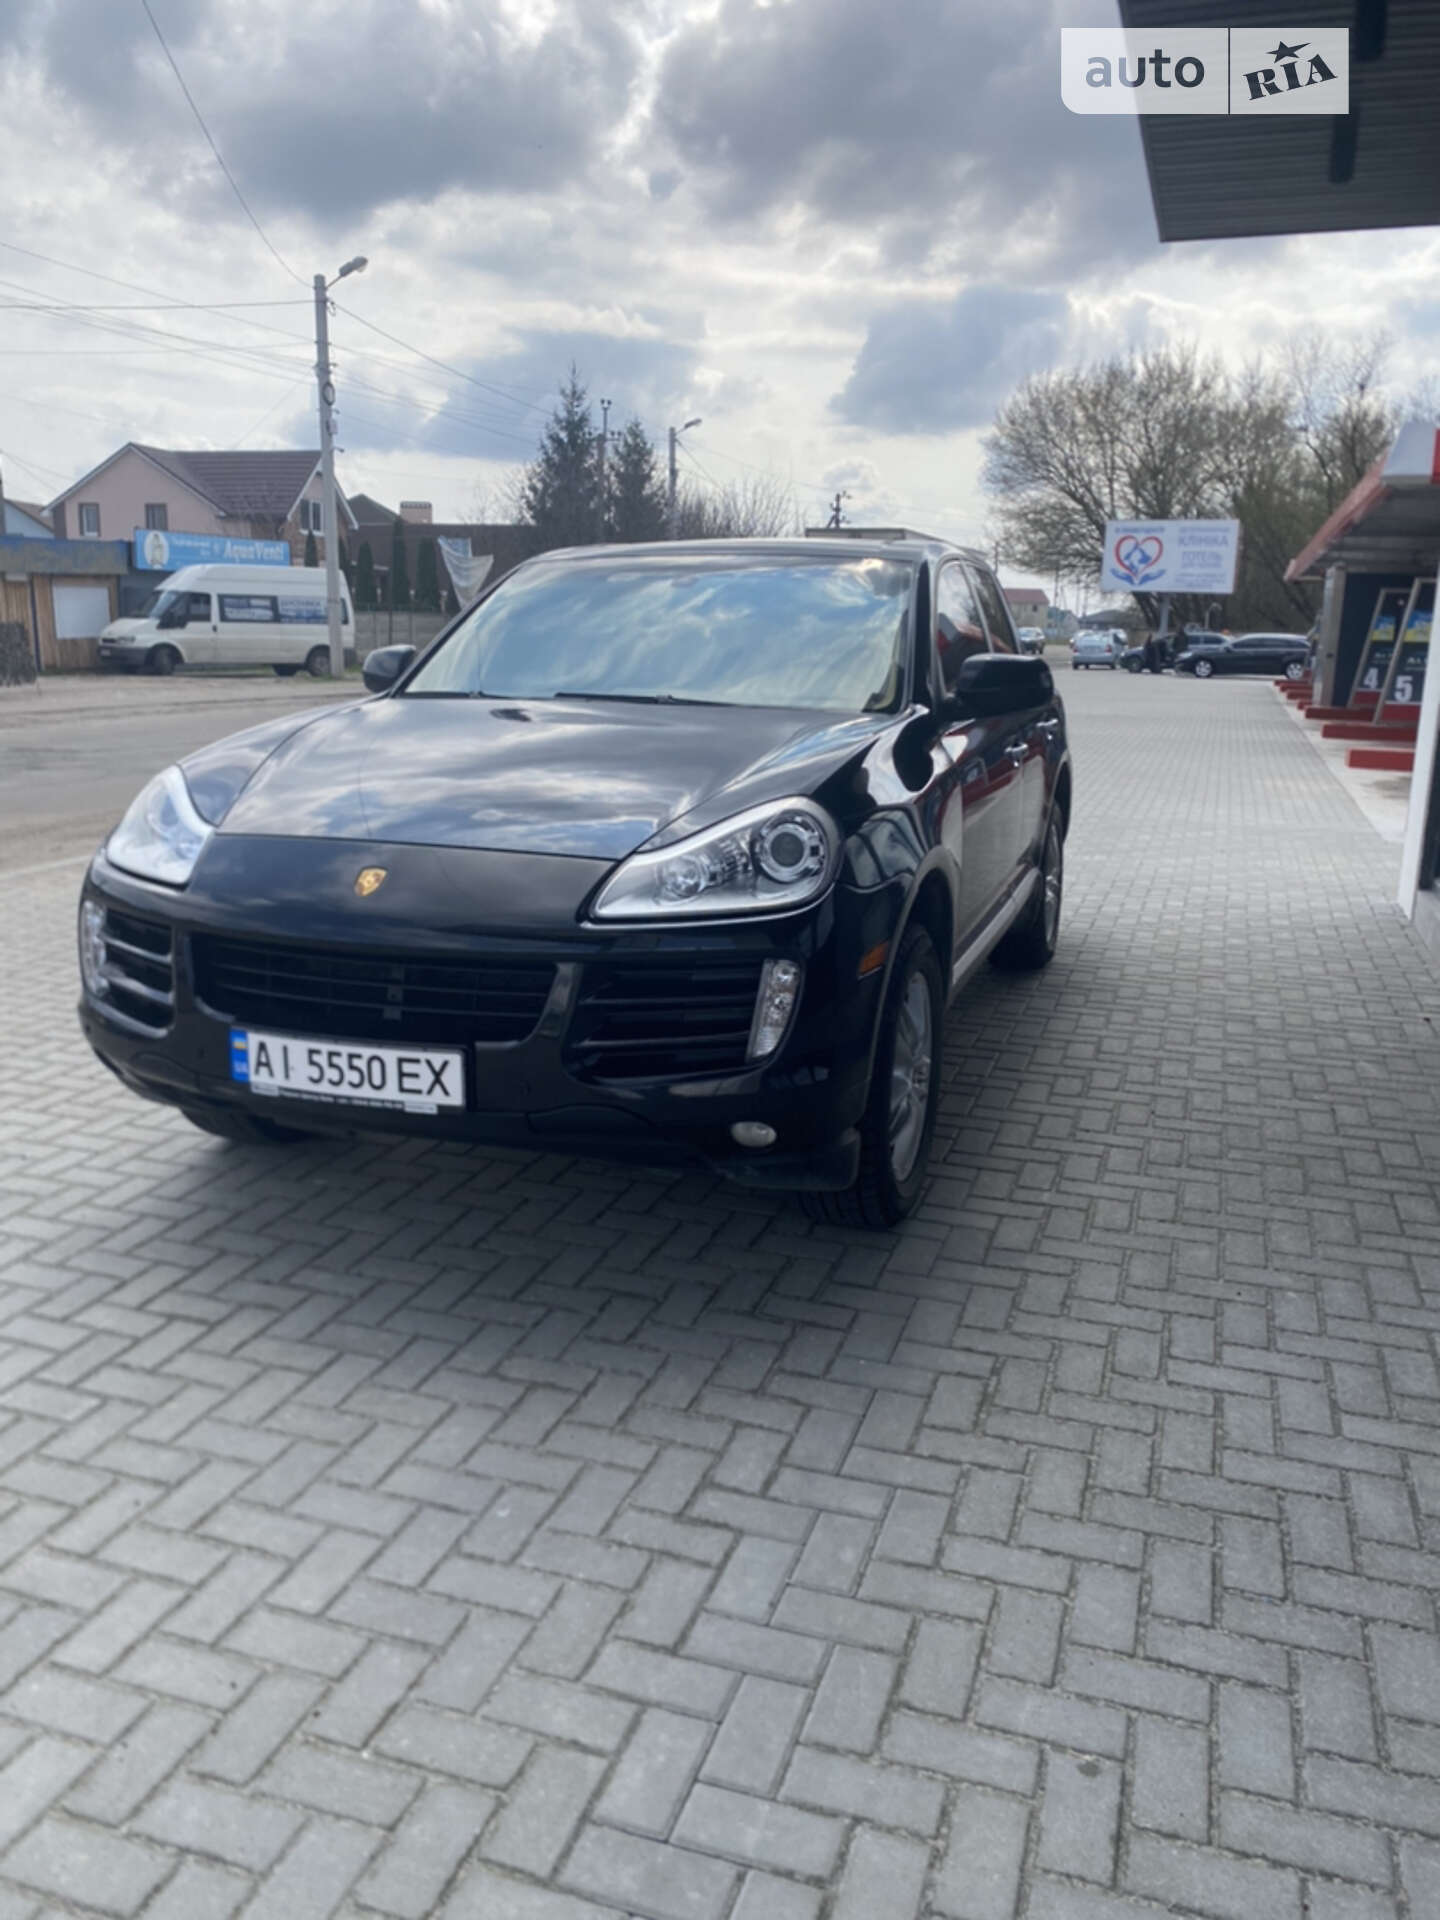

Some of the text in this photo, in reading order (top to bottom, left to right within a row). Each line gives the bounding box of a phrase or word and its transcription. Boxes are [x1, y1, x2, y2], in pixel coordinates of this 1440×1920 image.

[1363, 667, 1378, 689] 4
[1394, 675, 1413, 703] 5
[255, 1041, 451, 1097] AI 5550 EX
